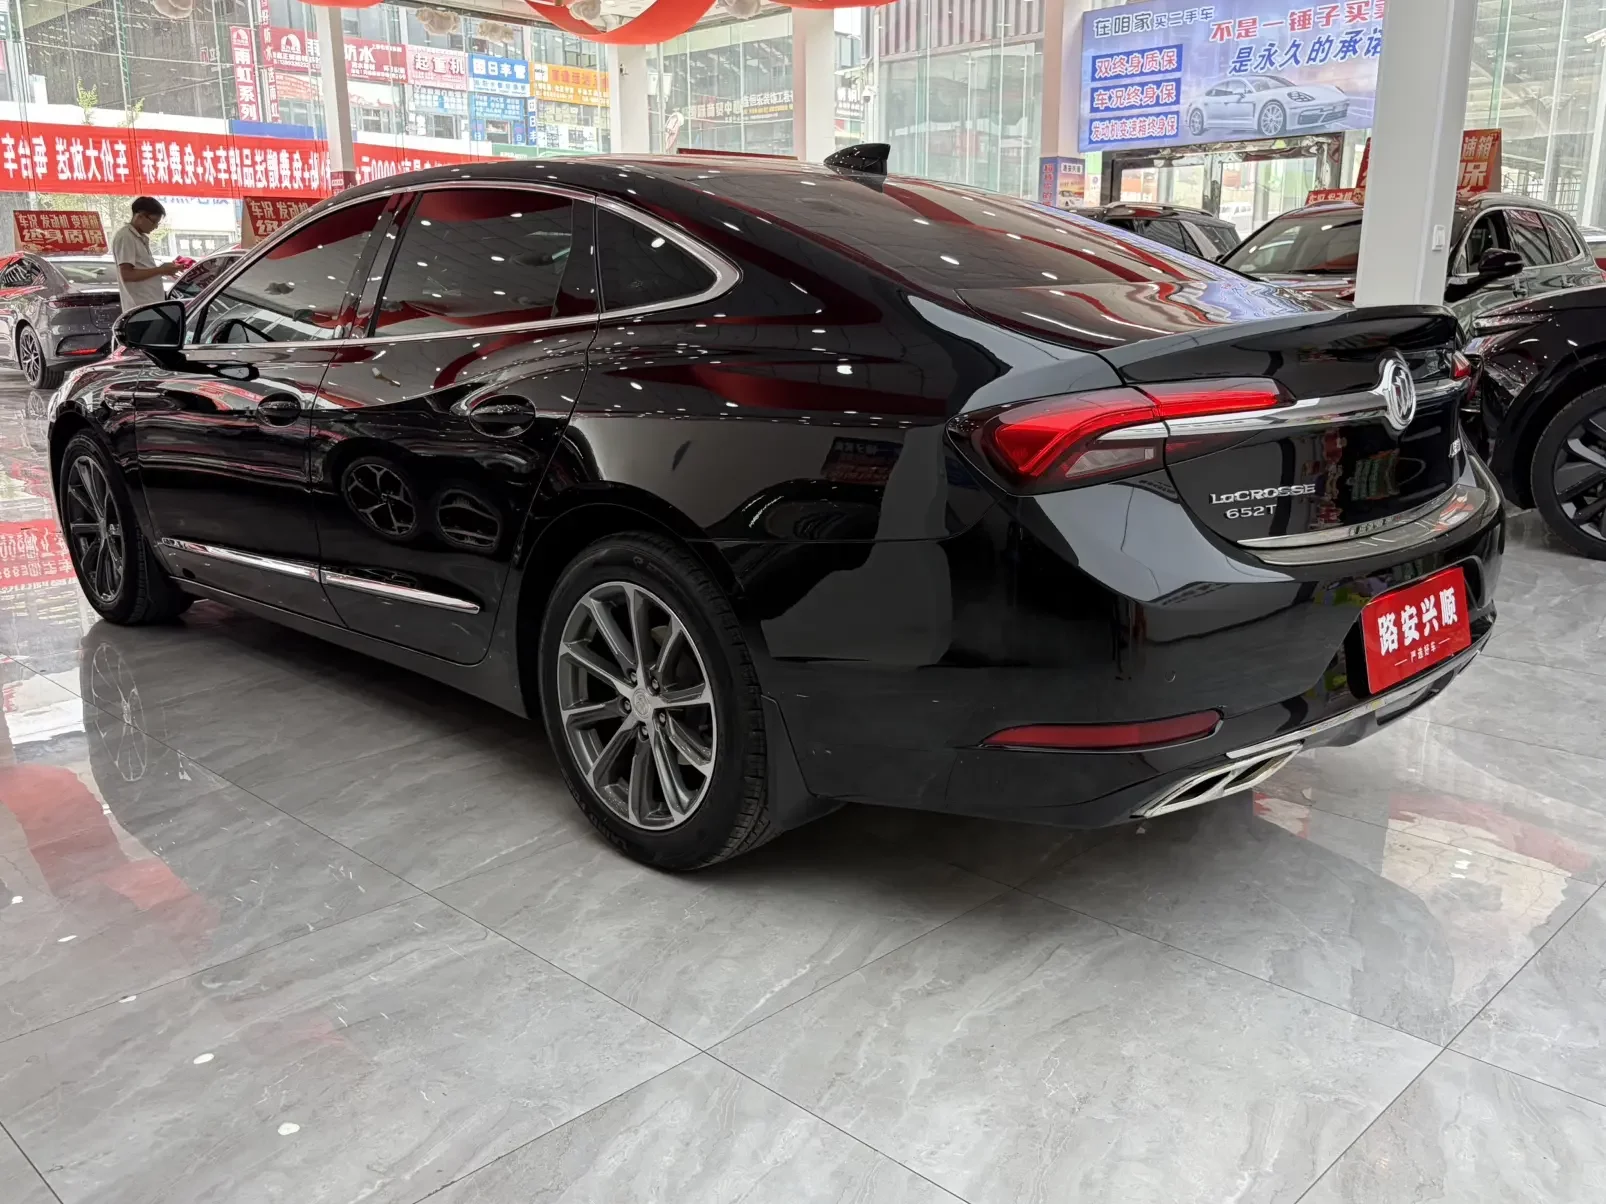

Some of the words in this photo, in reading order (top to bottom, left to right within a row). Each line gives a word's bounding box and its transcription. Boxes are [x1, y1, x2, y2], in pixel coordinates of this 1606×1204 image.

[414, 53, 465, 75] 起重机
[1096, 50, 1177, 78] 双终身质保
[234, 48, 257, 121] 雨虹系列
[1094, 82, 1176, 109] 车况终身保
[1091, 115, 1177, 140] 发动机变速箱终身保
[19, 214, 39, 228] 车况
[41, 214, 70, 228] 发动机
[71, 214, 100, 228] 变速箱
[251, 201, 276, 219] 车况
[23, 229, 105, 244] 终身质保
[1225, 504, 1277, 519] 652T
[1378, 586, 1458, 656] 路安兴顺
[1410, 641, 1437, 663] 严选好车
